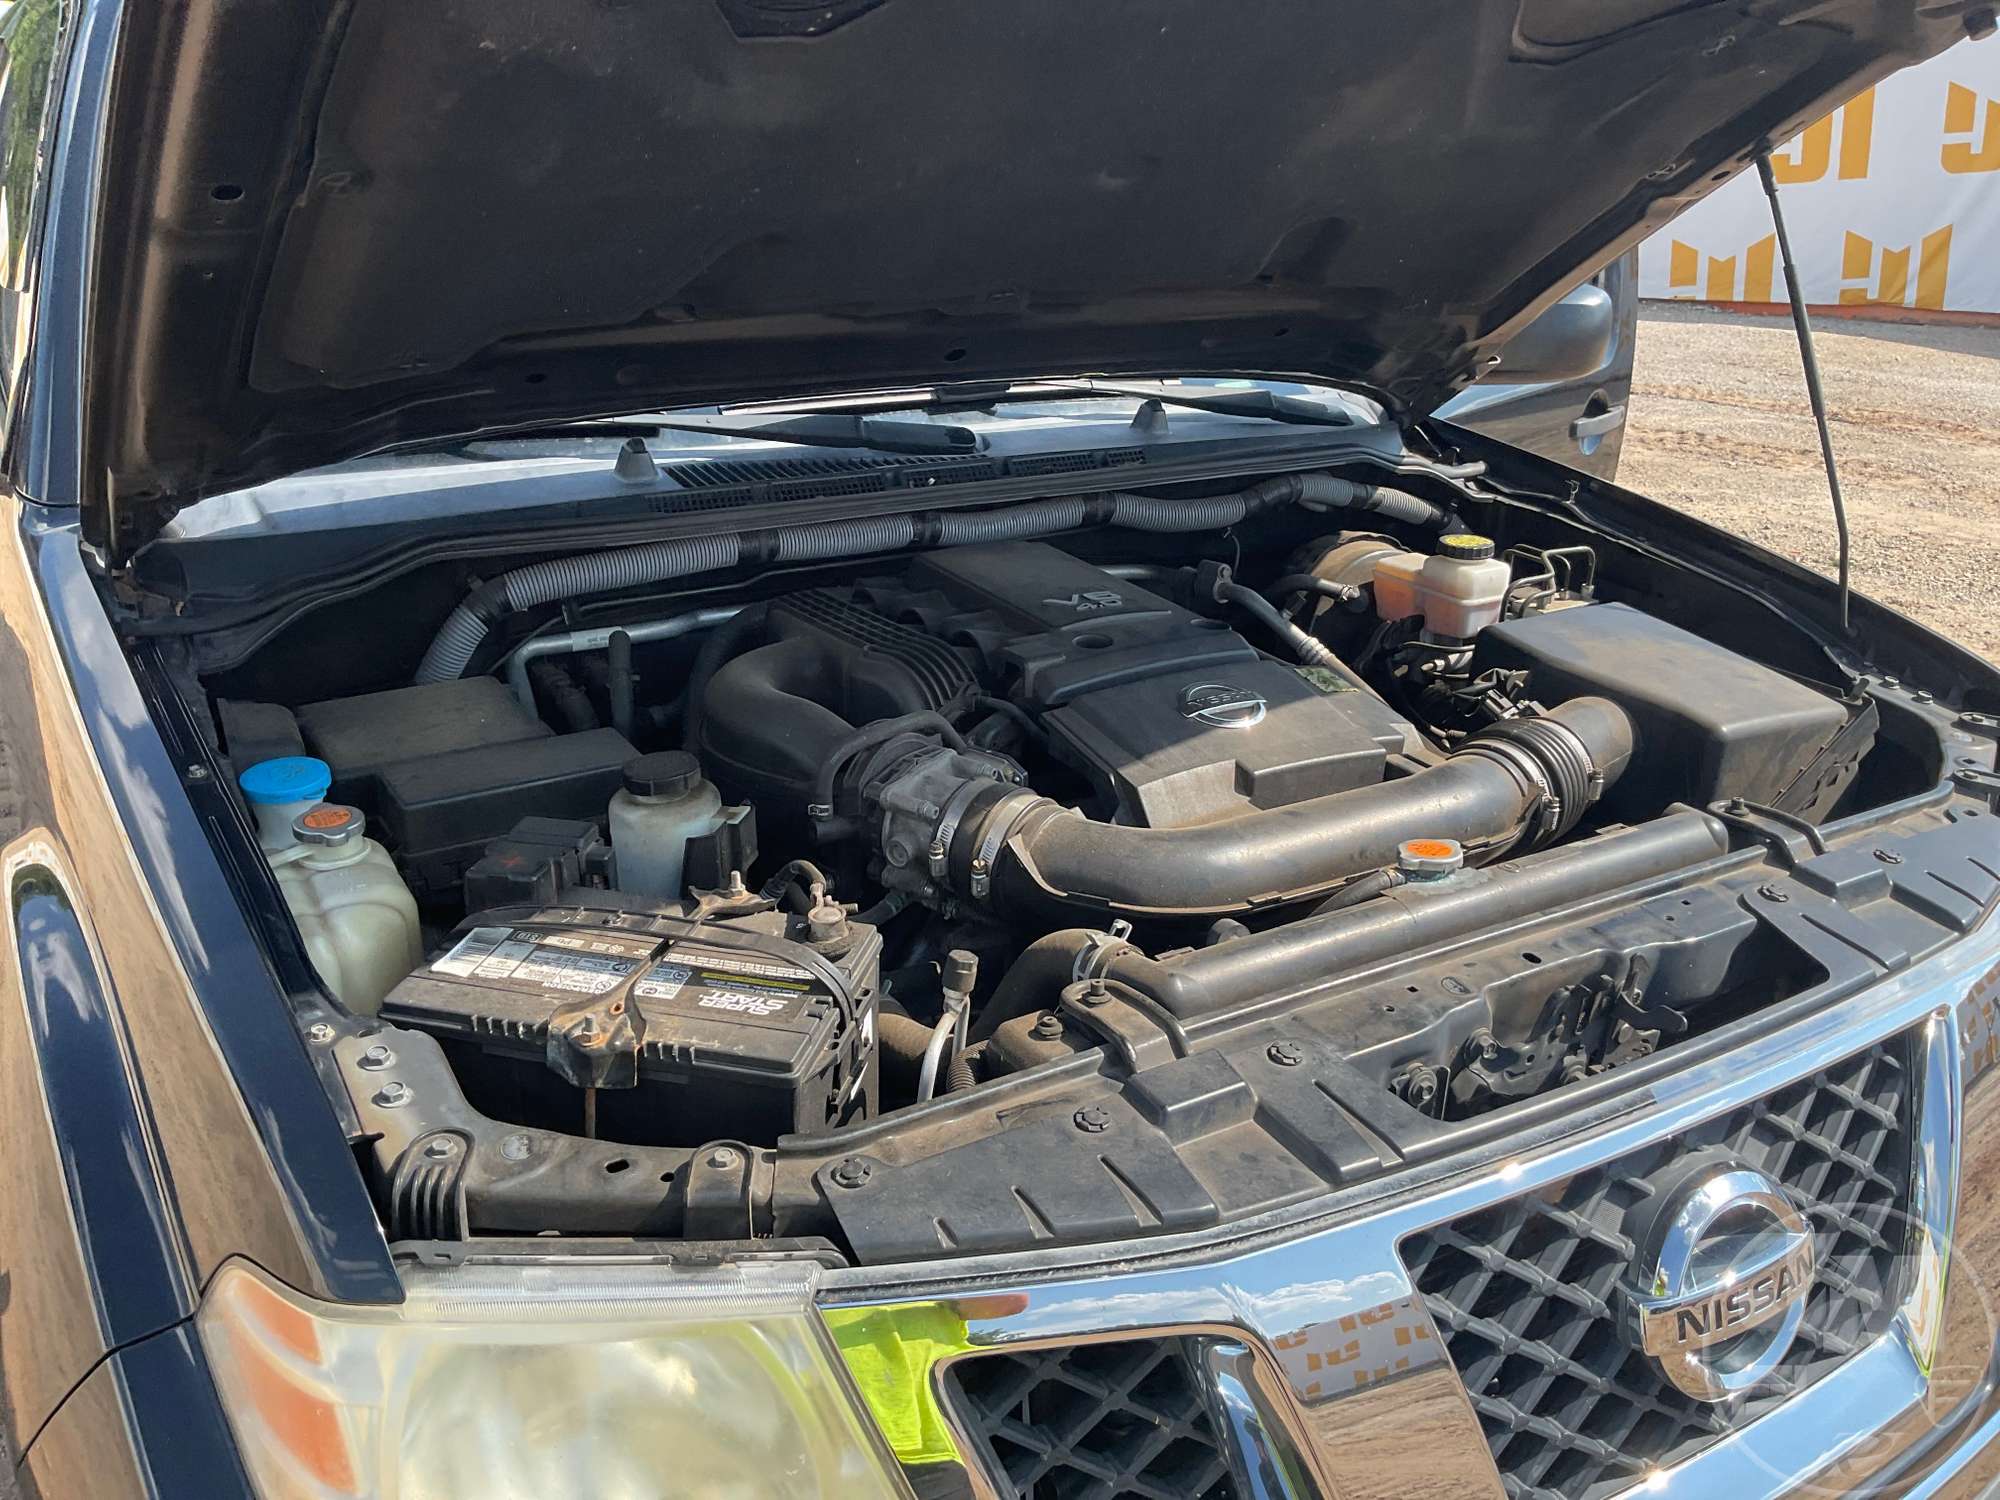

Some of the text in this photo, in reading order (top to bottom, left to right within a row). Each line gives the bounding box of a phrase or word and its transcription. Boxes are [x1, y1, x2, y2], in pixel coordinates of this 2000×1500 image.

[698, 995, 770, 1016] SUPER
[710, 990, 788, 1010] START
[1676, 1246, 1814, 1342] NISSAN
